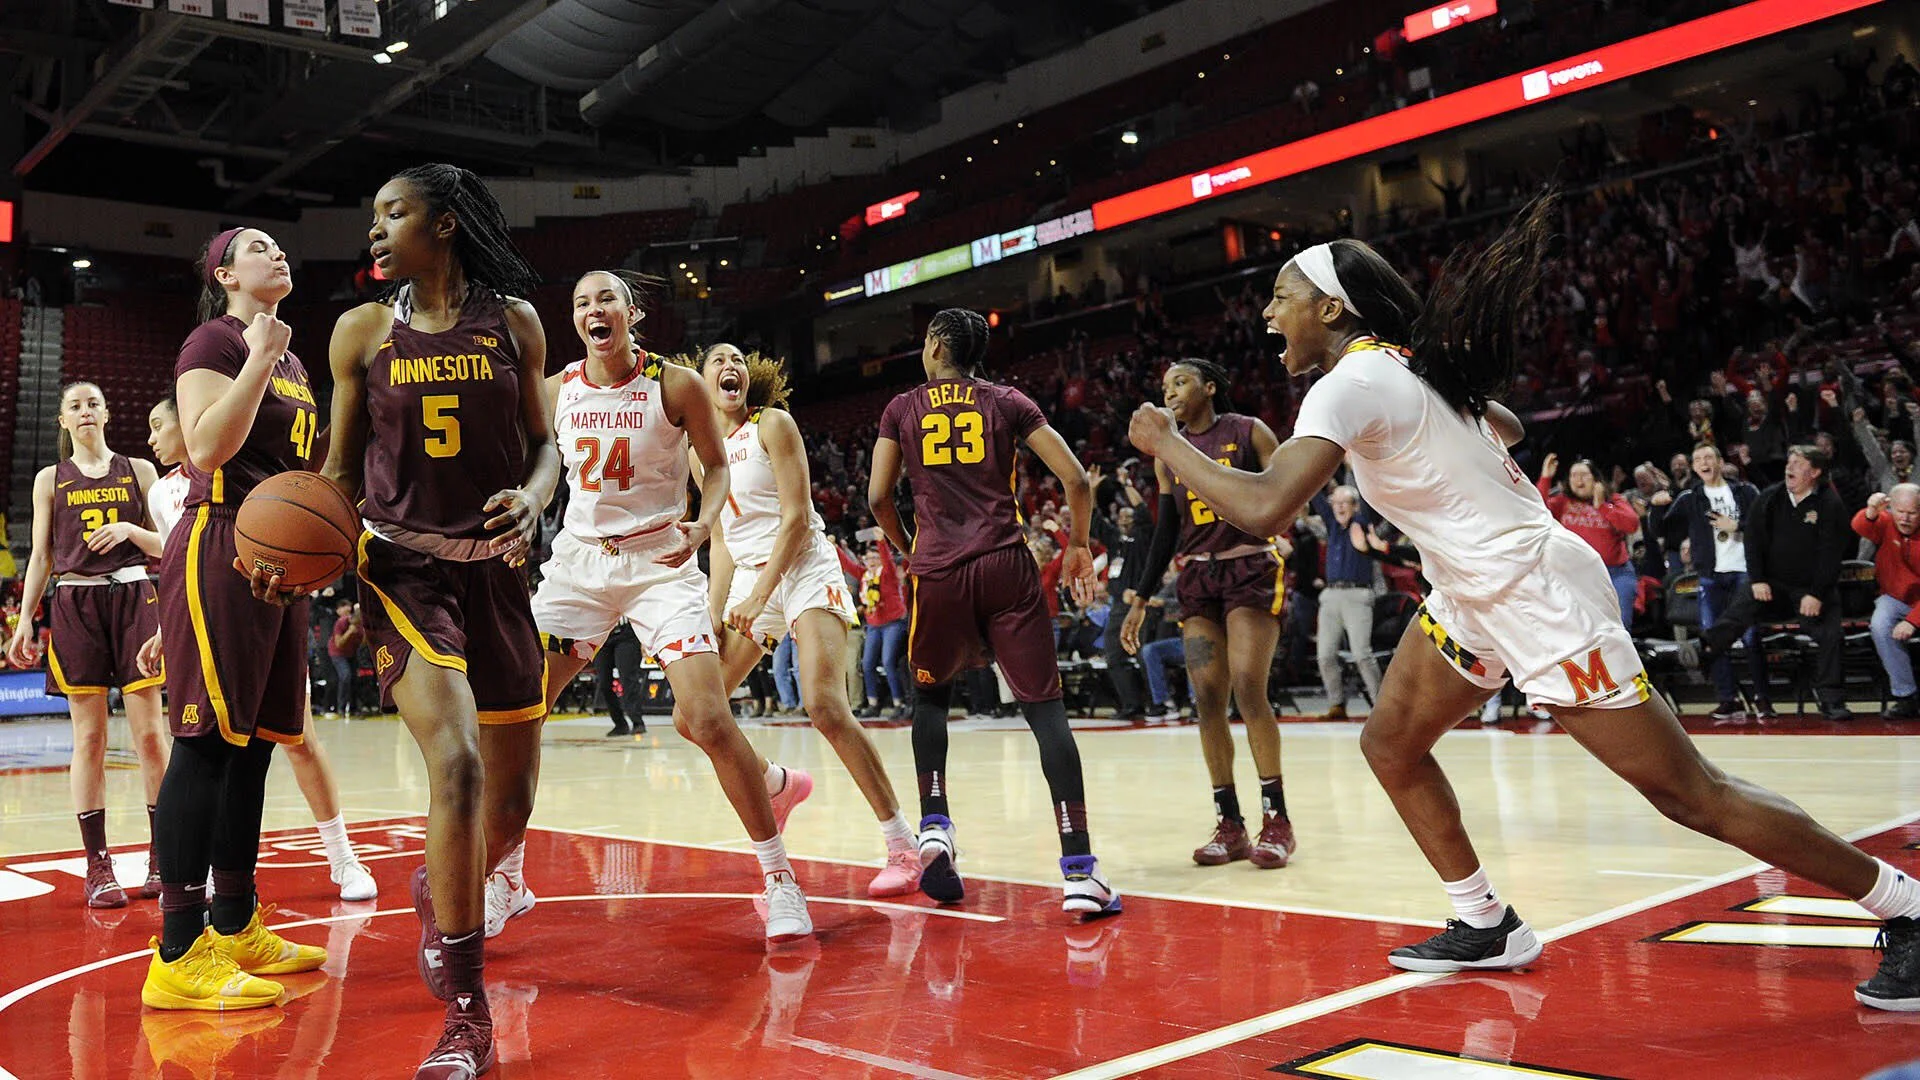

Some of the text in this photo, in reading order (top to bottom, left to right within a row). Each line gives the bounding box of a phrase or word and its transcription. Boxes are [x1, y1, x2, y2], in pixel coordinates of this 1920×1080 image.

[1548, 60, 1603, 86] TOYOTA
[390, 354, 494, 387] MINNESOTA
[928, 383, 975, 409] BELL
[290, 407, 316, 461] 41
[421, 394, 461, 459] 5
[571, 411, 643, 430] MARYLAND
[921, 411, 986, 466] 23
[575, 436, 635, 492] 24
[67, 487, 129, 506] MINNESOTA
[81, 507, 119, 543] 31
[825, 583, 847, 611] M
[1557, 647, 1619, 704] M
